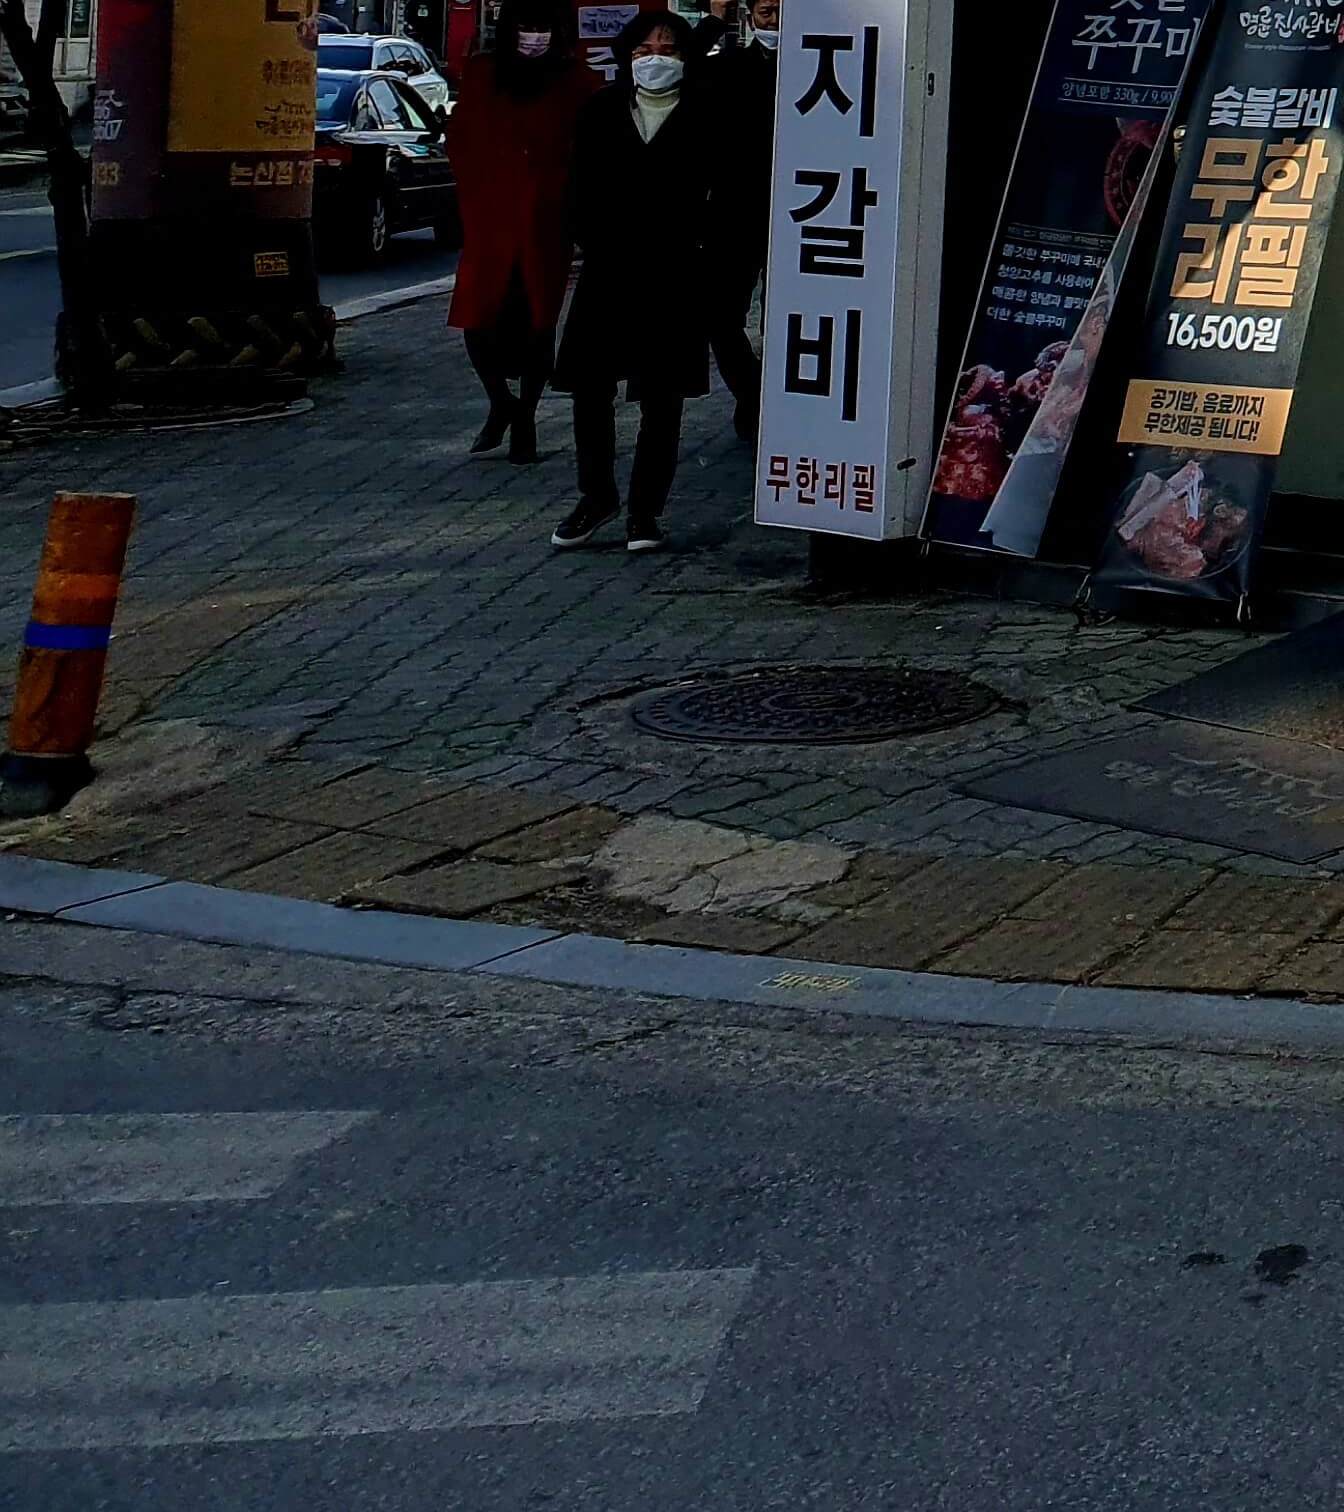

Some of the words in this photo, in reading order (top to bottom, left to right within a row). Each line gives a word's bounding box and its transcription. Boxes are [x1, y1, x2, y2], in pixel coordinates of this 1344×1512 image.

[1239, 5, 1341, 38] 명륜진사갈비
[1207, 87, 1338, 129] 숯불갈비
[1190, 136, 1329, 220] 무한
[1169, 223, 1308, 308] 리필
[1166, 311, 1283, 354] 16,500원
[1149, 388, 1199, 413] 공기밥,
[1203, 393, 1264, 419] 음료까지
[1143, 413, 1205, 437] 무한제공
[1207, 415, 1259, 442] 됩니다!
[765, 455, 877, 514] 무한리필
